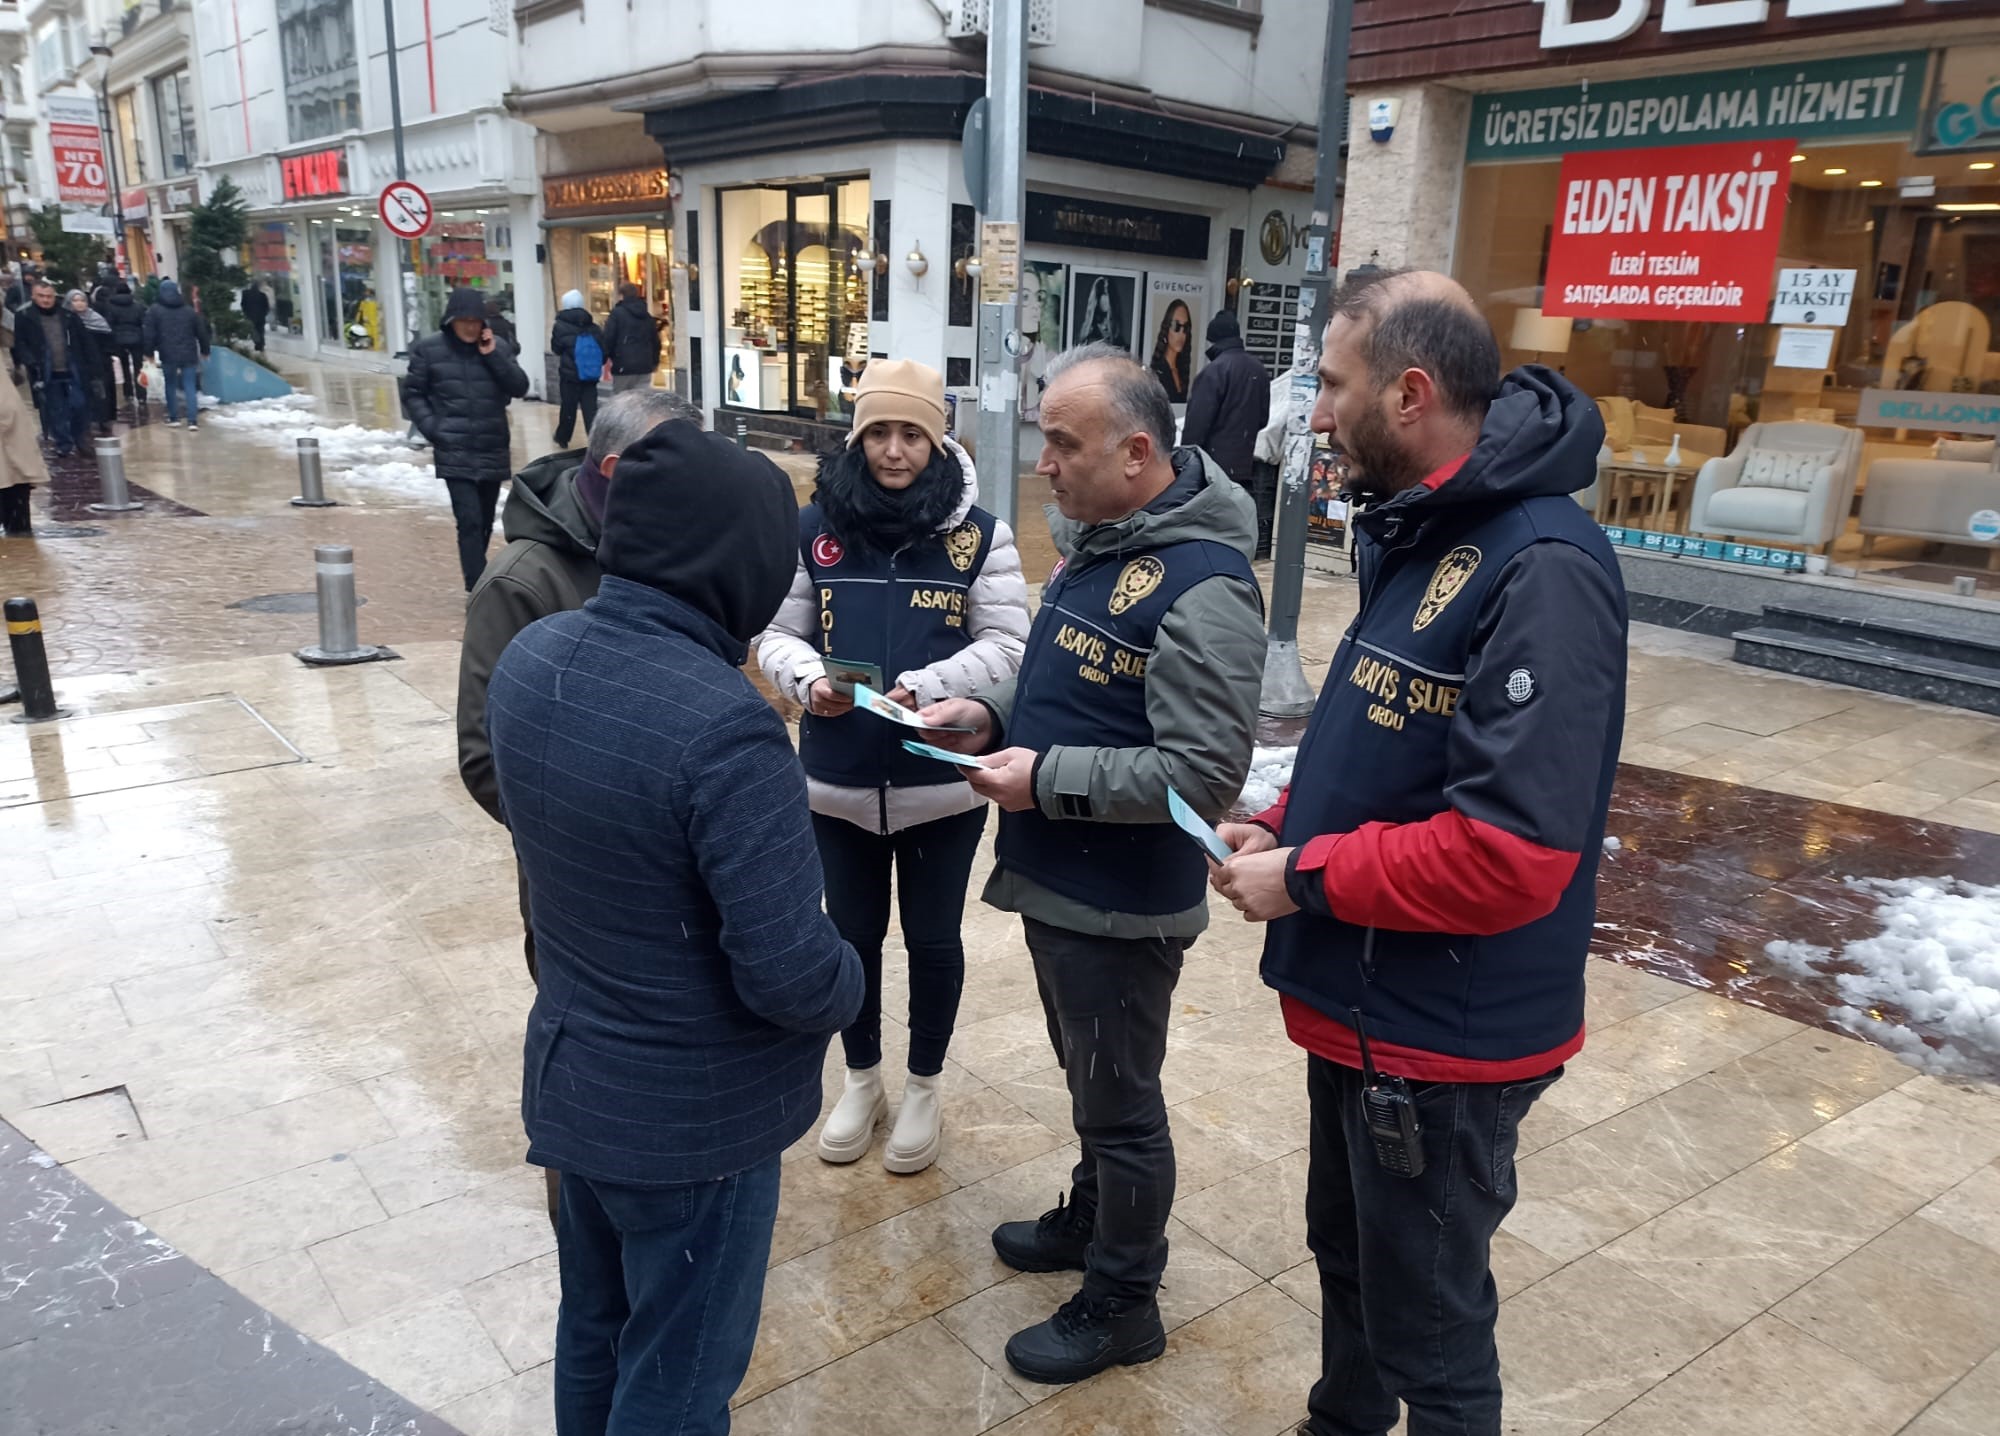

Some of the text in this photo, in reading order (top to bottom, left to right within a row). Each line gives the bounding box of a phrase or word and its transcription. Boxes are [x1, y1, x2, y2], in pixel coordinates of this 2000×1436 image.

[1484, 64, 1906, 145] ÜCRETSİZ DEPOLAMA HİZMETİ
[63, 151, 97, 163] NET
[1562, 151, 1778, 235] ELDEN TAKSİT
[1609, 250, 1700, 275] İLERİ TESLİM
[1154, 280, 1204, 294] GIVENCHY
[1791, 273, 1845, 287] 15 AY
[1563, 281, 1743, 309] SATIŞLARDA GEÇERLİDİR
[1778, 289, 1851, 306] TAKSİT
[910, 589, 962, 614] ASAYİŞ
[820, 588, 834, 657] POL
[1054, 623, 1106, 666] ASAYİŞ
[1079, 664, 1110, 685] ORDU
[1349, 655, 1400, 704] ASAYİŞ
[1367, 703, 1404, 731] ORDU
